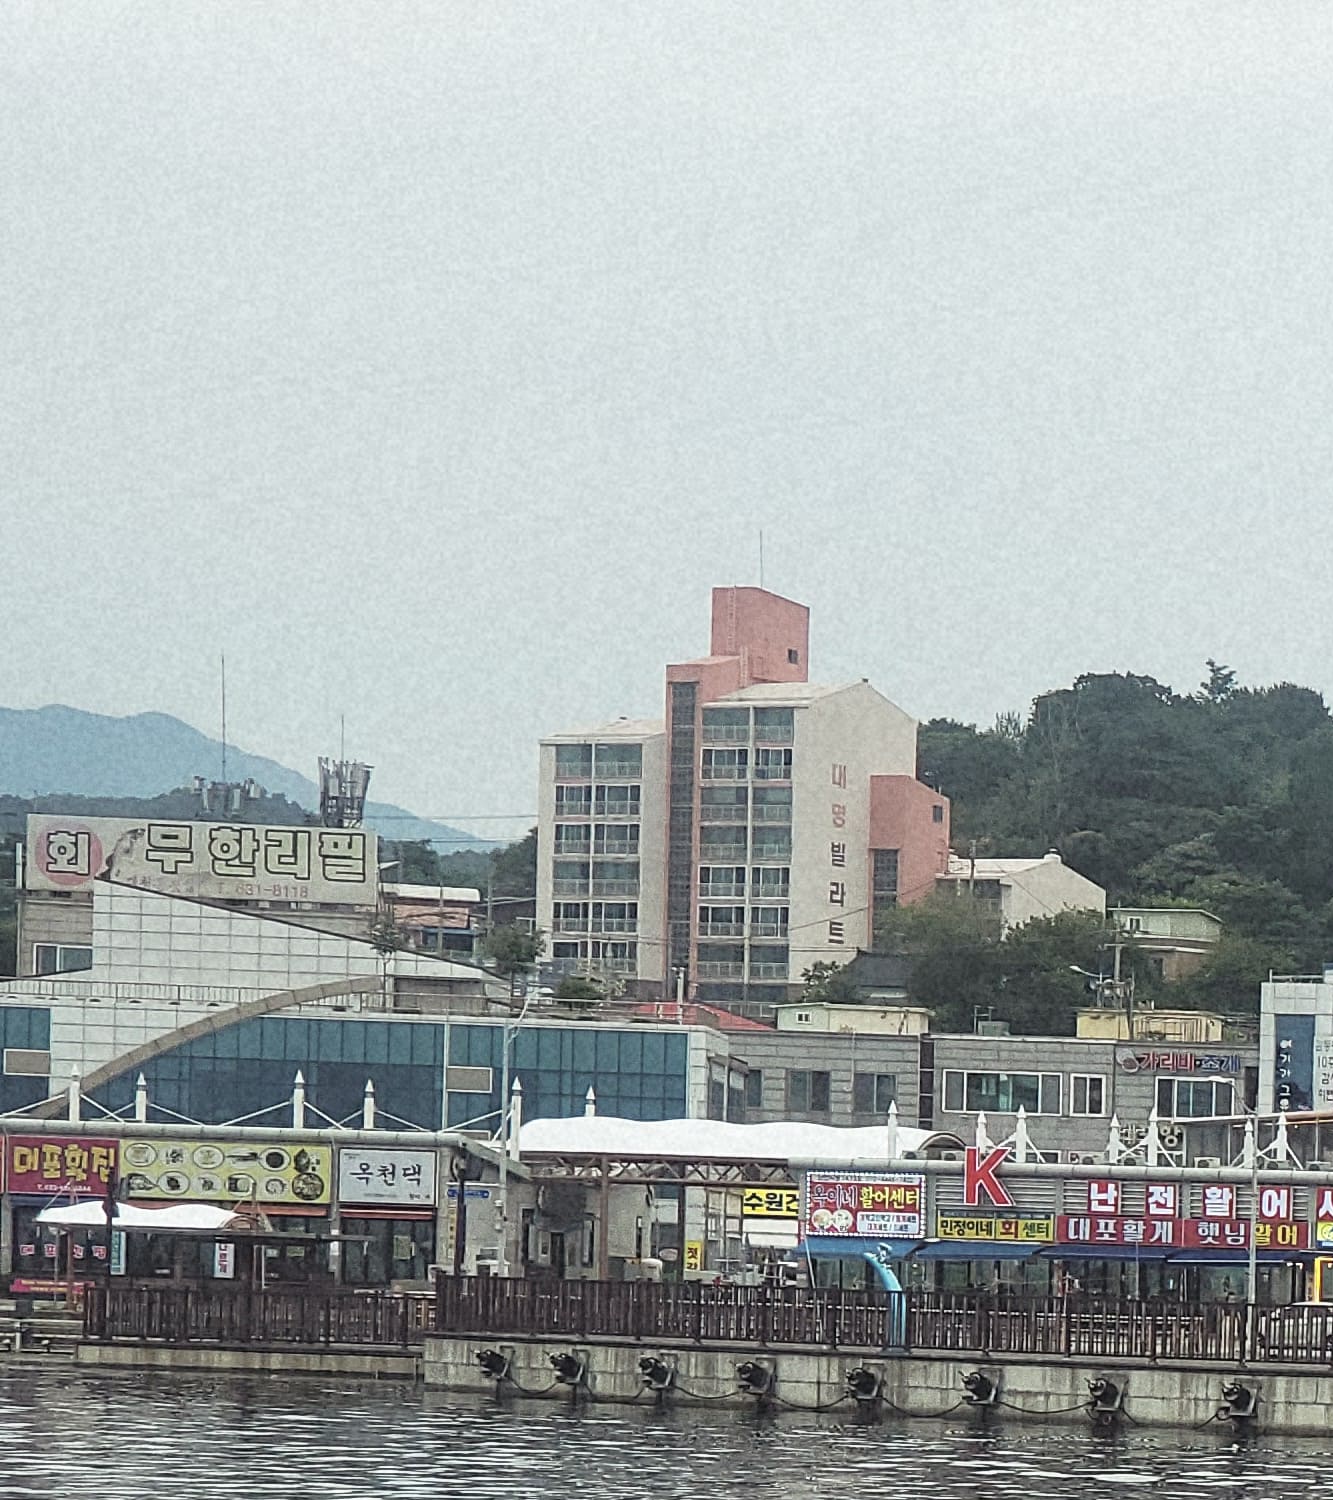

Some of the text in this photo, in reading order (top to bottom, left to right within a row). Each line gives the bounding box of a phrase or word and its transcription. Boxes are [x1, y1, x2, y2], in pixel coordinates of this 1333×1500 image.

[46, 824, 366, 882] 회 무한리필
[350, 1162, 422, 1187] 옥천댁
[964, 1146, 1014, 1207] K
